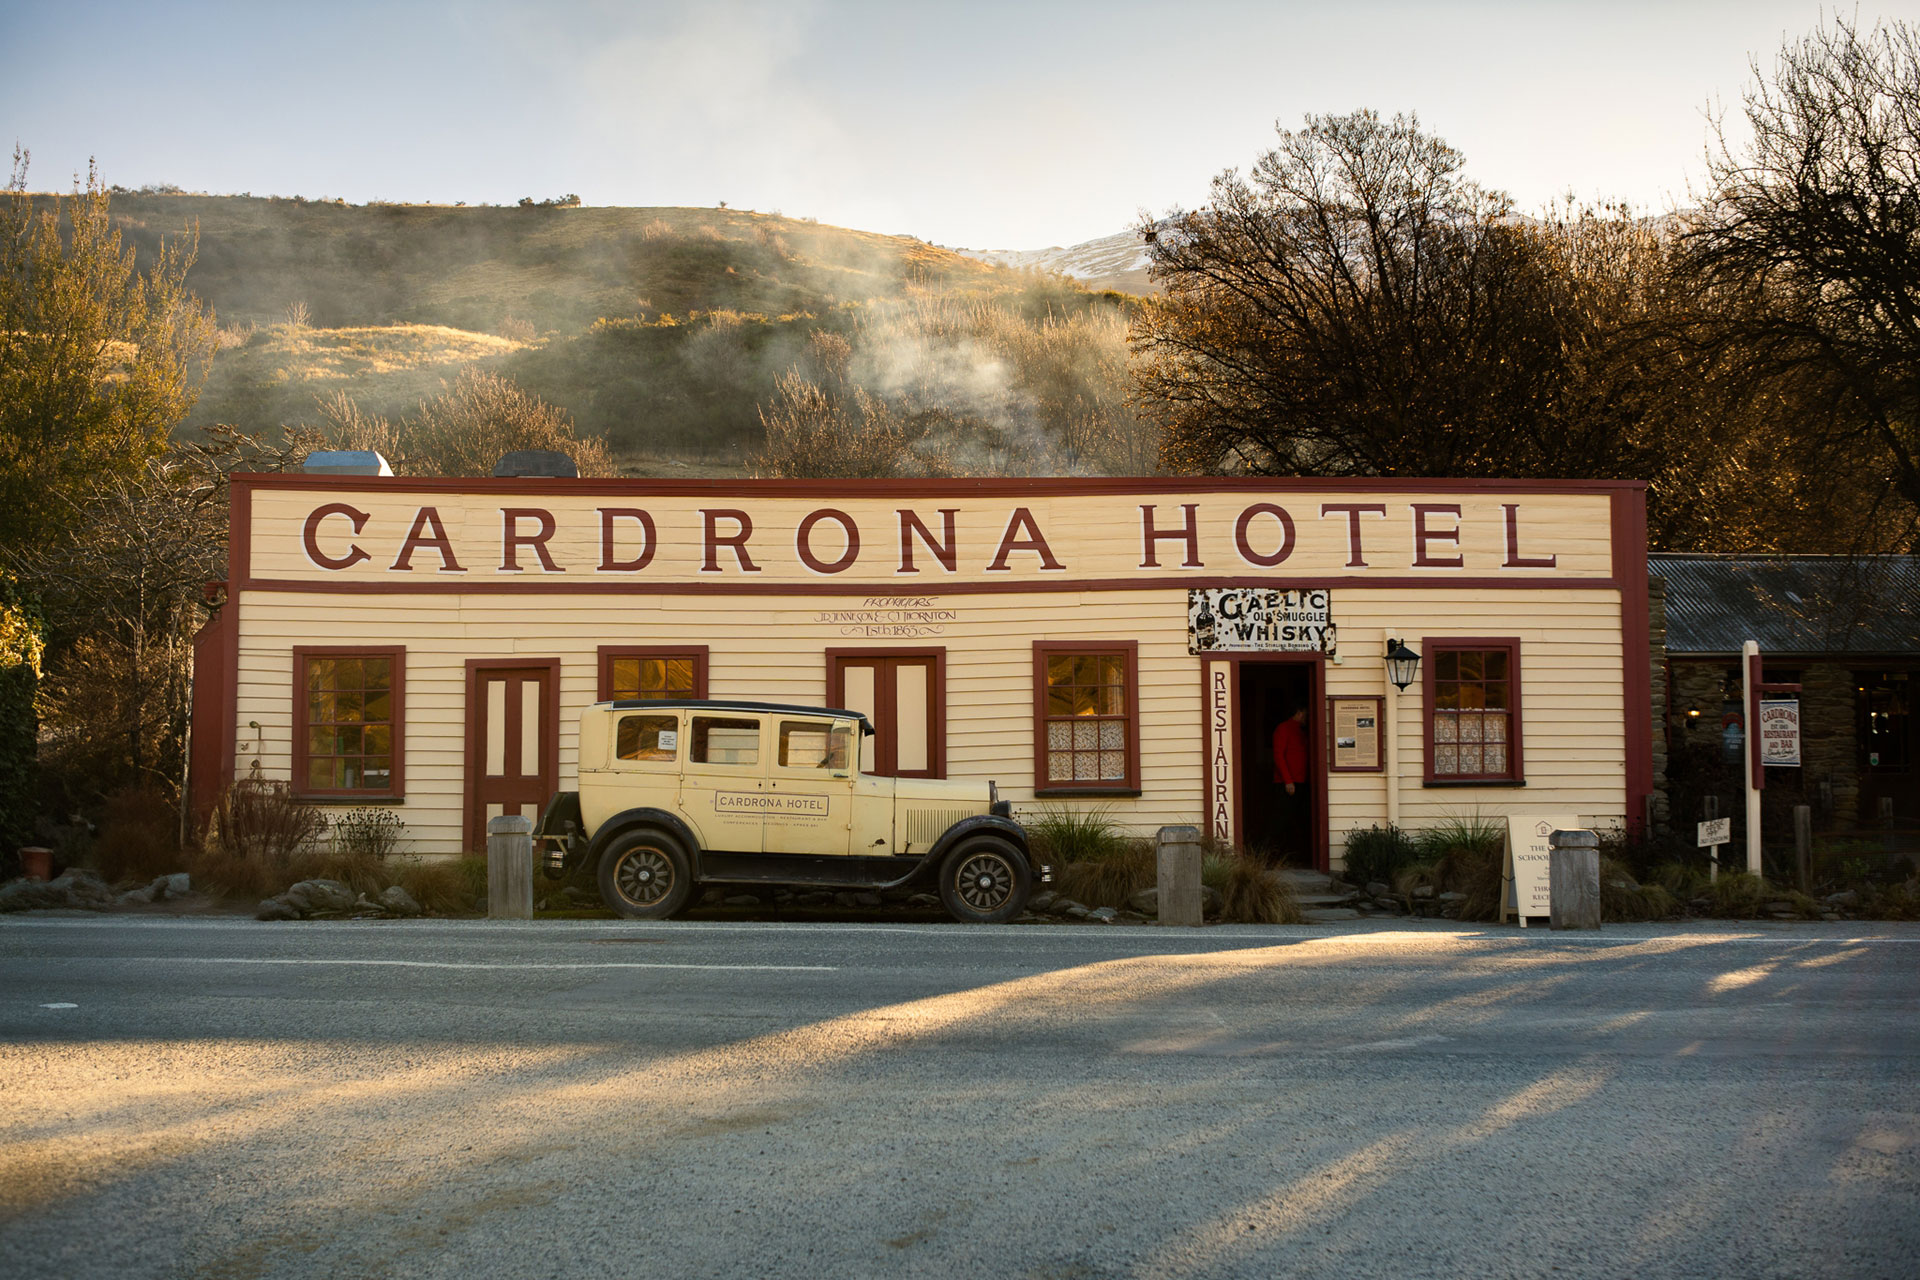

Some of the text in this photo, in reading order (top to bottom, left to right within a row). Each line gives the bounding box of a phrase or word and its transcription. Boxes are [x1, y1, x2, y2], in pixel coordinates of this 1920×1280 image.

[303, 501, 1557, 574] CARDRONA HOTEL
[1218, 592, 1326, 620] GAELIC
[903, 610, 956, 623] THORNTON
[1277, 611, 1328, 622] SMUGGLE
[1235, 623, 1327, 642] WHISKY
[1762, 709, 1797, 725] CARDRONA
[1781, 740, 1793, 748] BAR
[1214, 671, 1230, 847] RESTAURAN
[720, 796, 823, 809] CARDRONA HOTEL
